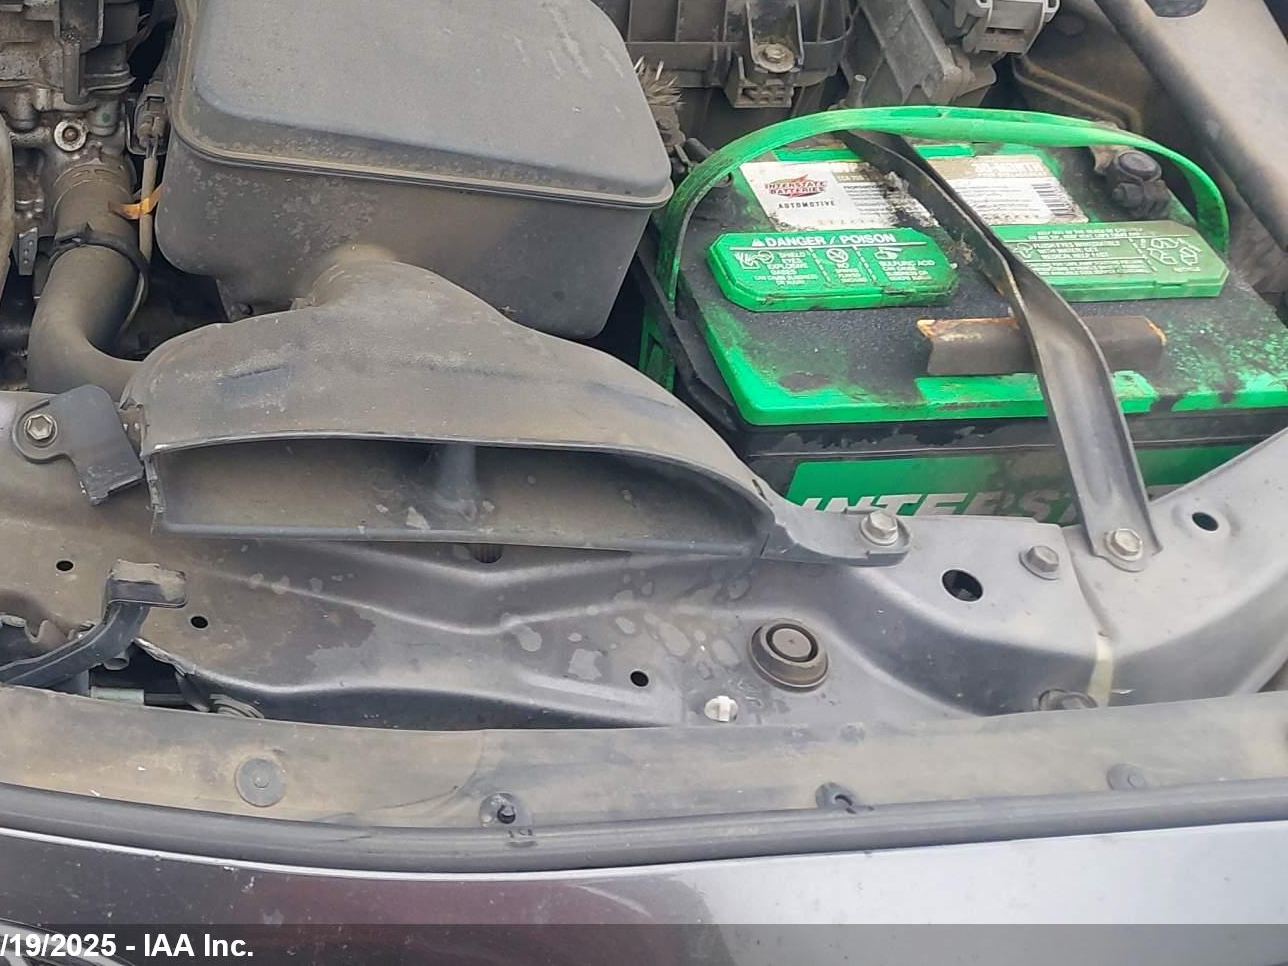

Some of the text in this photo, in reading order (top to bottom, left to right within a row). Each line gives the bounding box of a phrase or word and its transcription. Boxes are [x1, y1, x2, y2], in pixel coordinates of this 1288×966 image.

[764, 180, 826, 189] INTERSTATE
[769, 186, 825, 195] BATTERIES
[778, 200, 836, 209] AUTOMOTIVE
[764, 236, 826, 247] DANGER
[840, 234, 896, 245] POISON
